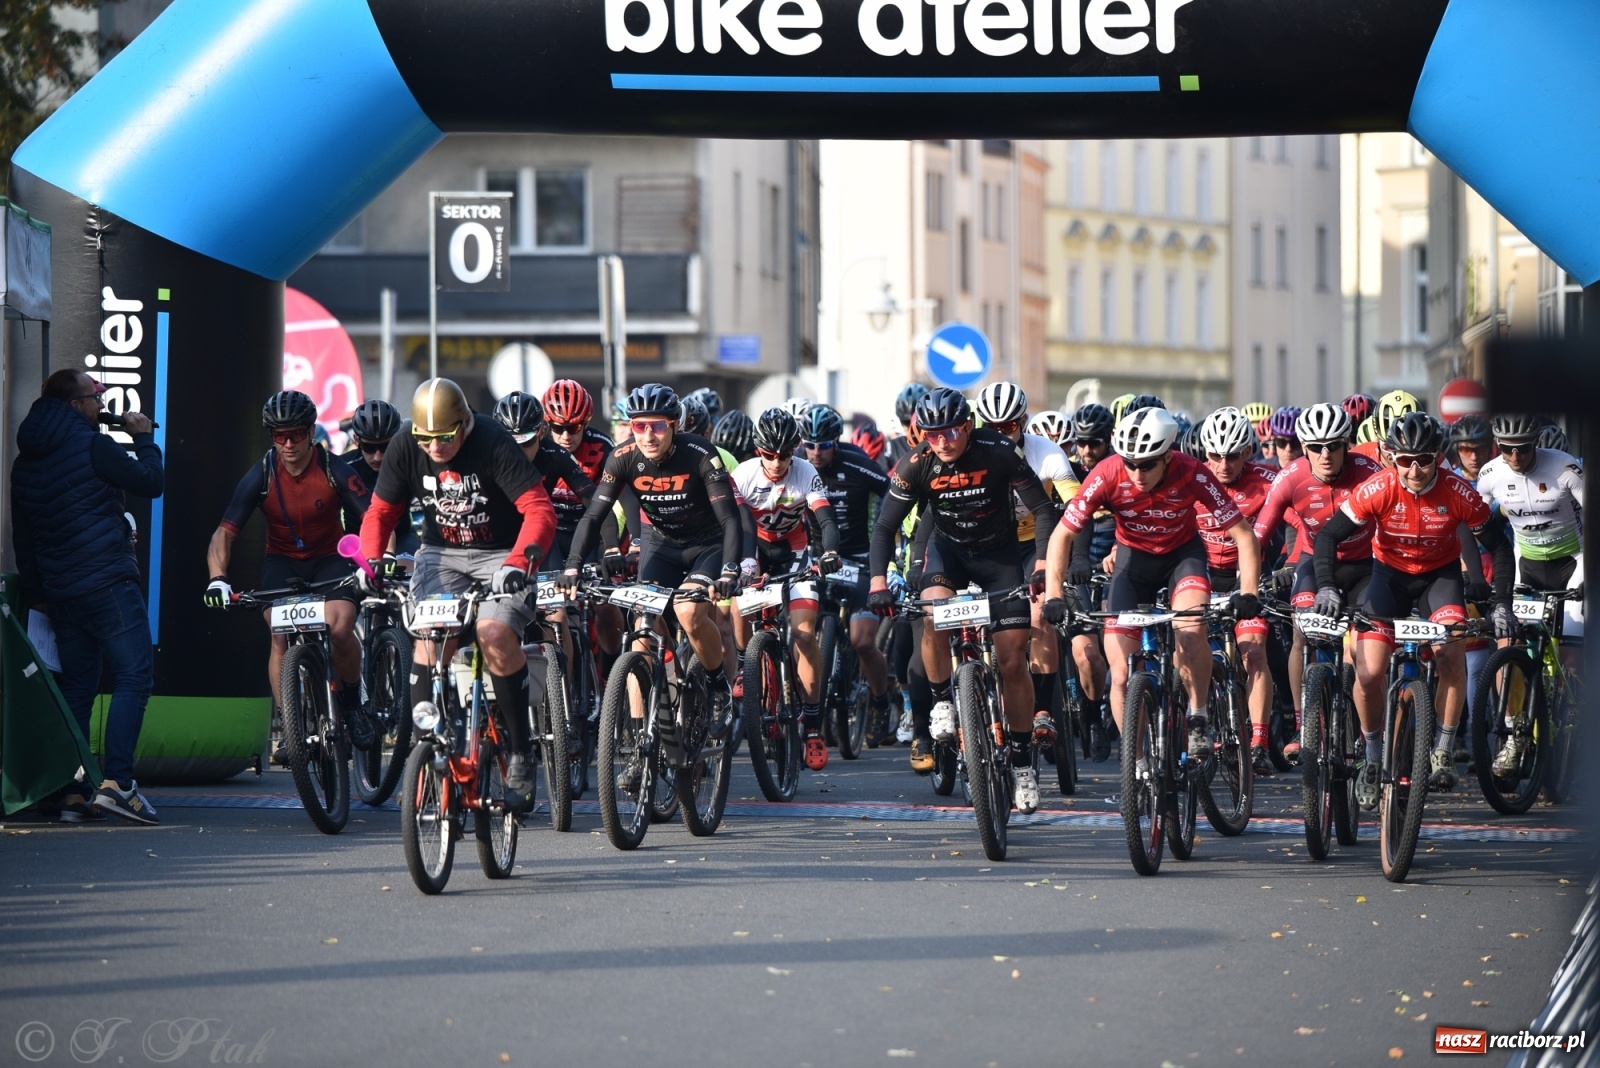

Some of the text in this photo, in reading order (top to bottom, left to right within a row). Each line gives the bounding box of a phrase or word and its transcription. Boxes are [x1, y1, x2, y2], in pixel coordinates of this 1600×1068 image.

[605, 0, 1193, 56] bike atelier
[442, 204, 502, 219] SEKTOR
[449, 221, 494, 284] 0
[633, 474, 690, 492] CST
[930, 470, 988, 490] CST
[623, 589, 660, 604] 1527
[281, 606, 317, 621] 1006
[418, 604, 456, 616] 1184
[943, 604, 980, 619] 2389
[1303, 616, 1339, 631] 2828
[1401, 624, 1440, 636] 2831
